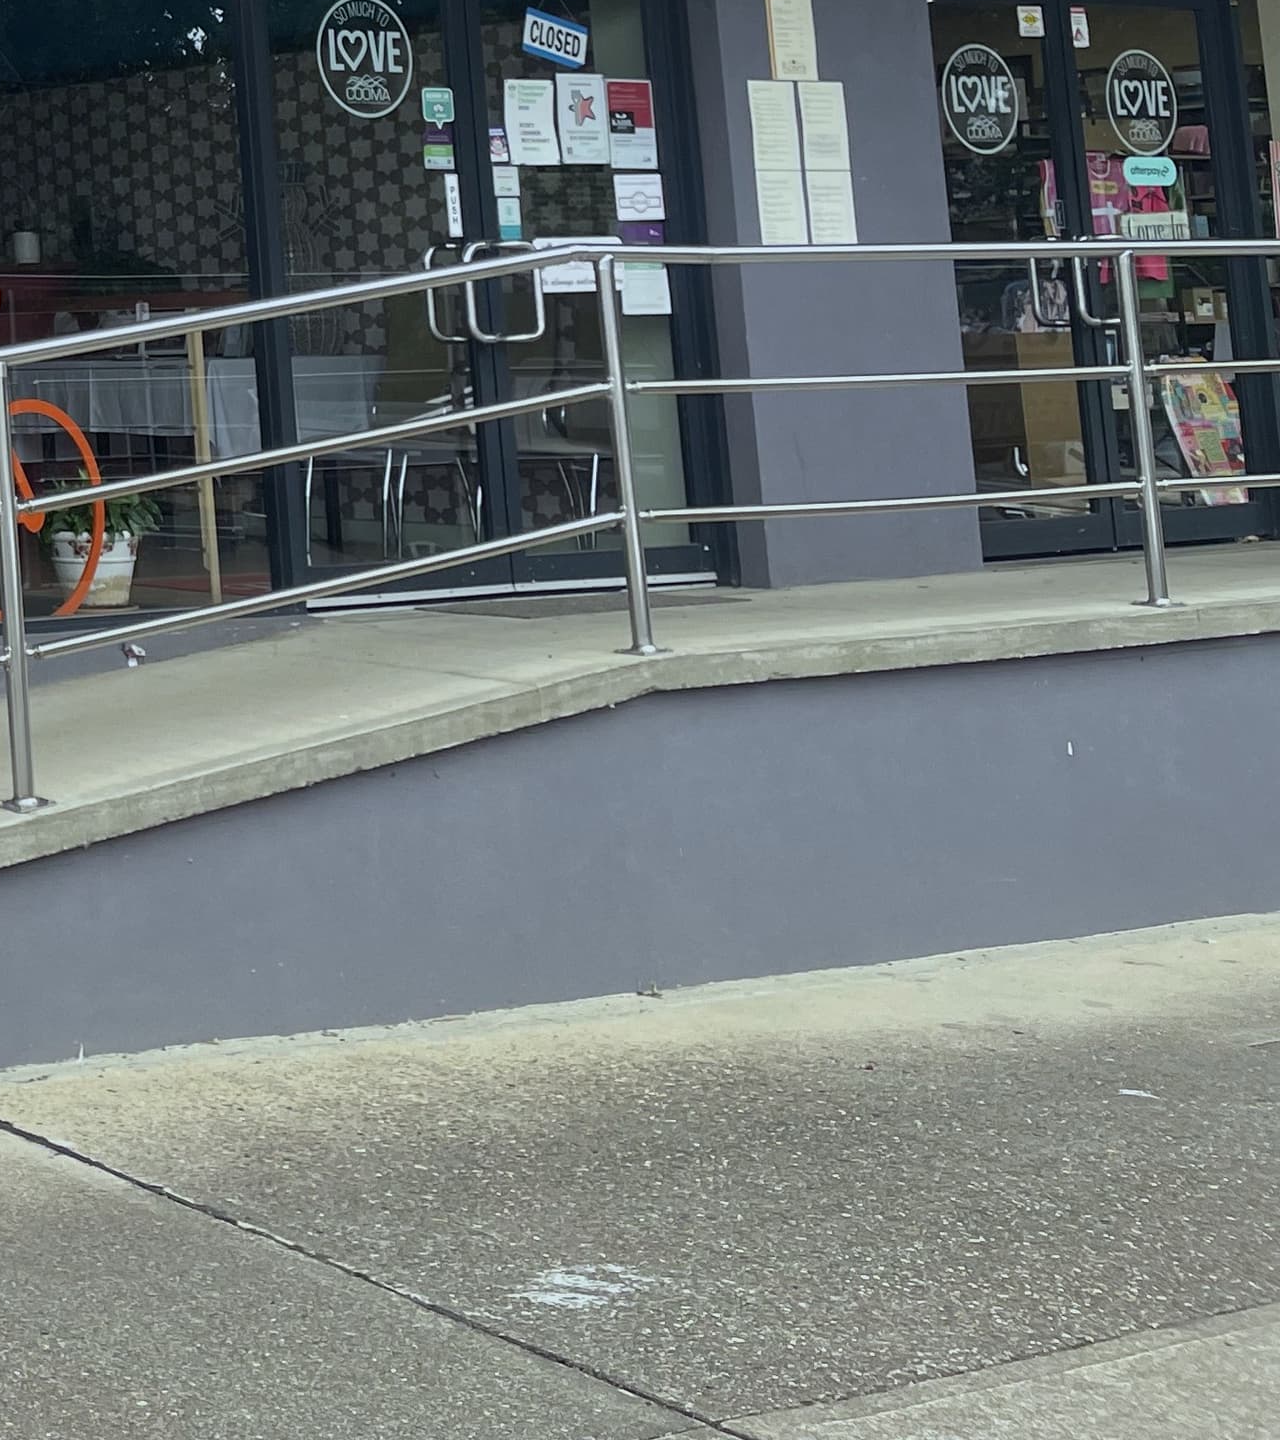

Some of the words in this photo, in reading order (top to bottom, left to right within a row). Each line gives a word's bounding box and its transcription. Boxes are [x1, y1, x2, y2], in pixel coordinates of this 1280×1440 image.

[333, 6, 349, 26] SO
[348, 0, 376, 19] MUCH
[375, 7, 390, 27] TO
[530, 20, 581, 58] CLOSED
[987, 55, 999, 73] TO
[345, 86, 391, 102] COOMA
[450, 185, 459, 225] PUSH
